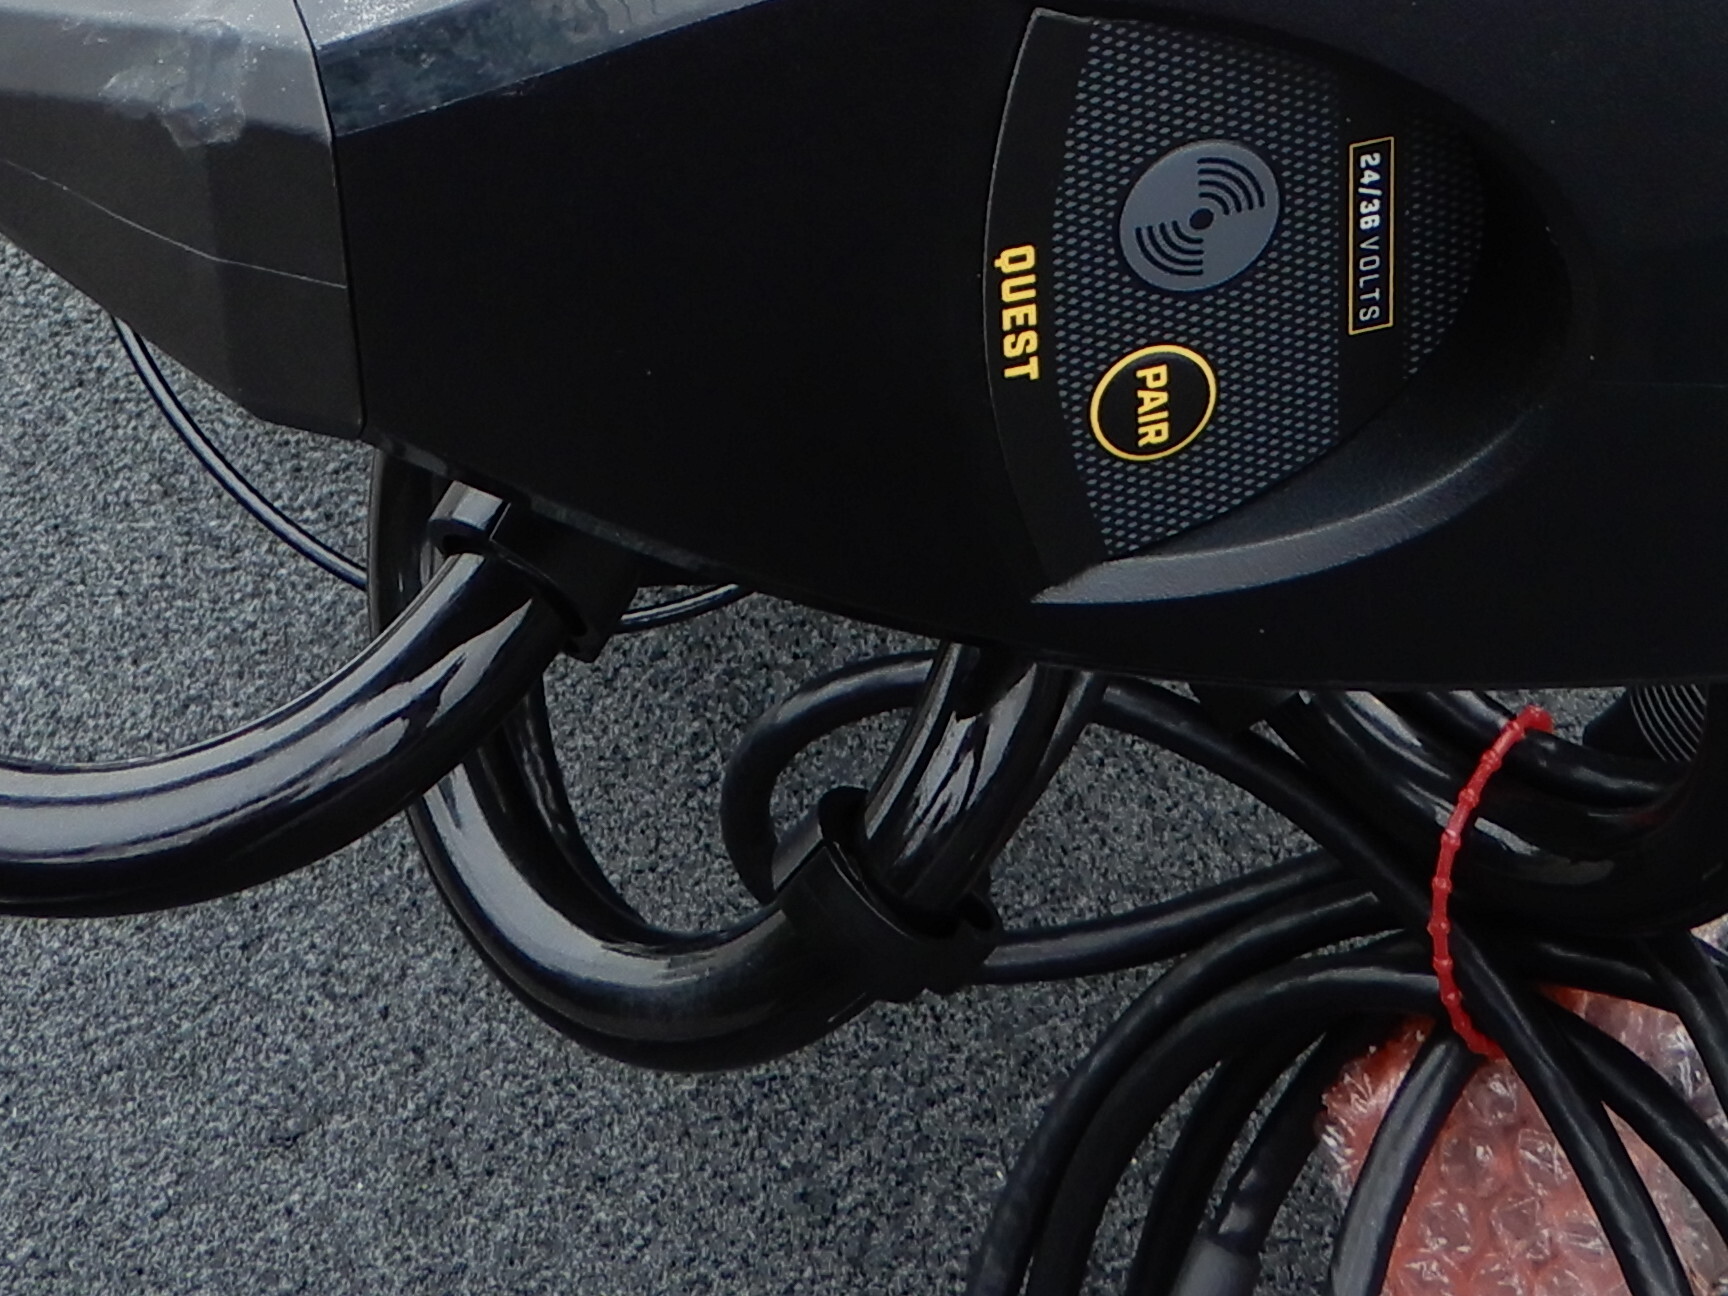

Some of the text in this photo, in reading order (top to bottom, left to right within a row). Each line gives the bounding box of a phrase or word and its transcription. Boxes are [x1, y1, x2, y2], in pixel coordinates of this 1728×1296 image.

[1358, 152, 1382, 322] 24/36 VOLTS
[994, 244, 1039, 380] QUEST
[1135, 363, 1169, 448] PAIR
